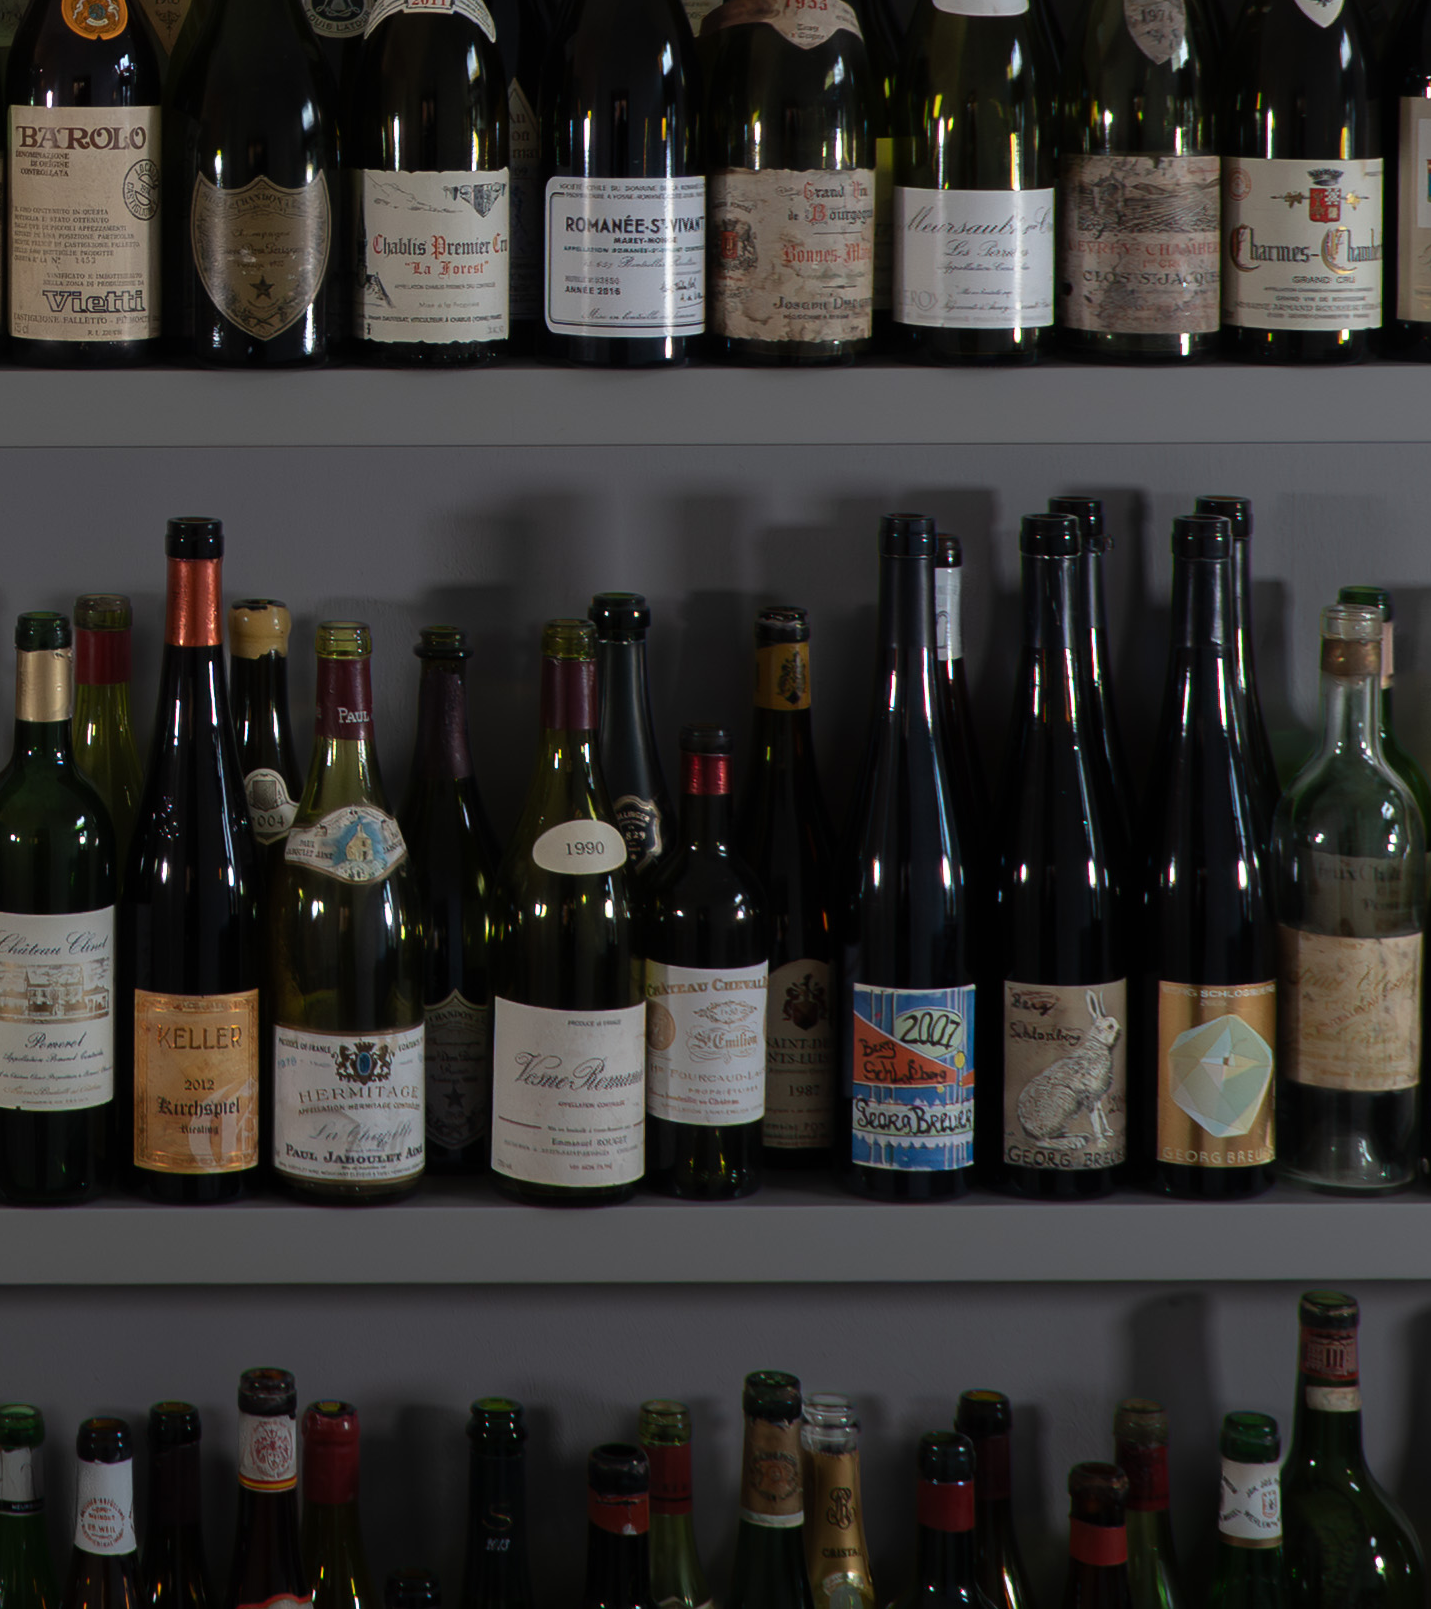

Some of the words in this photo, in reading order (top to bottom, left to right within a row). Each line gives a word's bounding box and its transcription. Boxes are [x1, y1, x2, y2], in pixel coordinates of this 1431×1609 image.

[15, 123, 147, 151] BAROLO
[42, 289, 146, 313] Vietti
[337, 707, 371, 724] PAUL
[564, 841, 606, 856] 1990
[156, 1023, 242, 1050] KELLER
[901, 1013, 960, 1048] 2007
[24, 1031, 82, 1052] Pomerol
[297, 1085, 420, 1103] HERMITAGE
[285, 1145, 318, 1161] PAUL
[322, 1145, 402, 1165] JABOULET
[1007, 1147, 1071, 1167] GEORG
